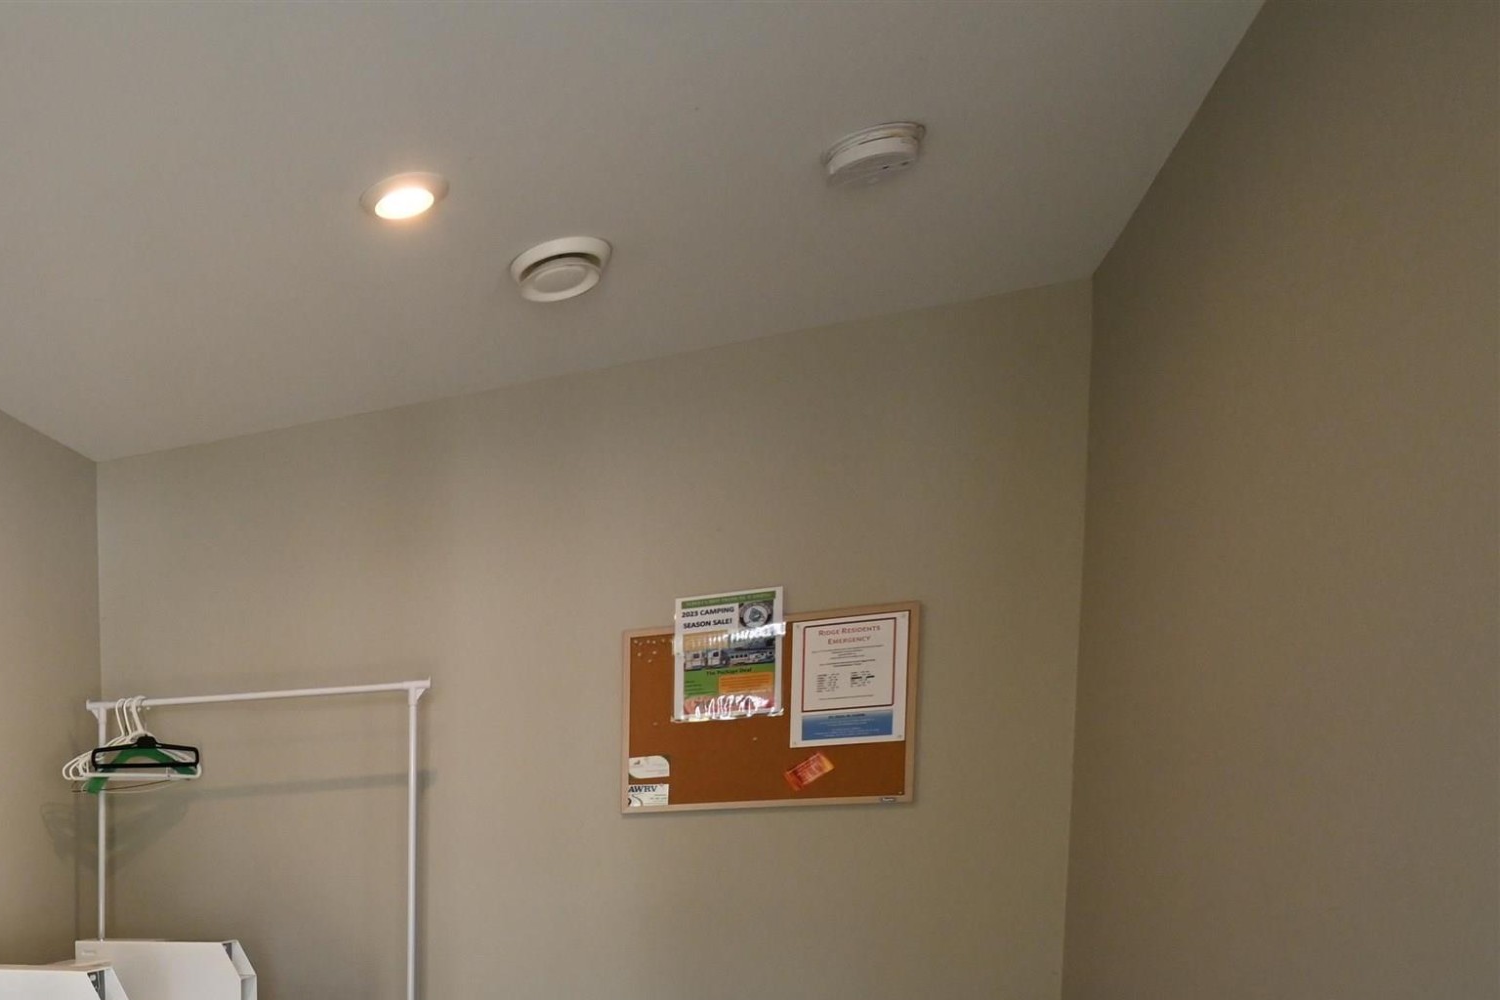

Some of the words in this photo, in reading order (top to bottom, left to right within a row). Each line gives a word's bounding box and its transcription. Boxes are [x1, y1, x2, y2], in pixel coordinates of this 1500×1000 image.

[700, 606, 734, 615] CAMPING
[683, 620, 711, 629] SEASON
[712, 617, 732, 626] SALE!
